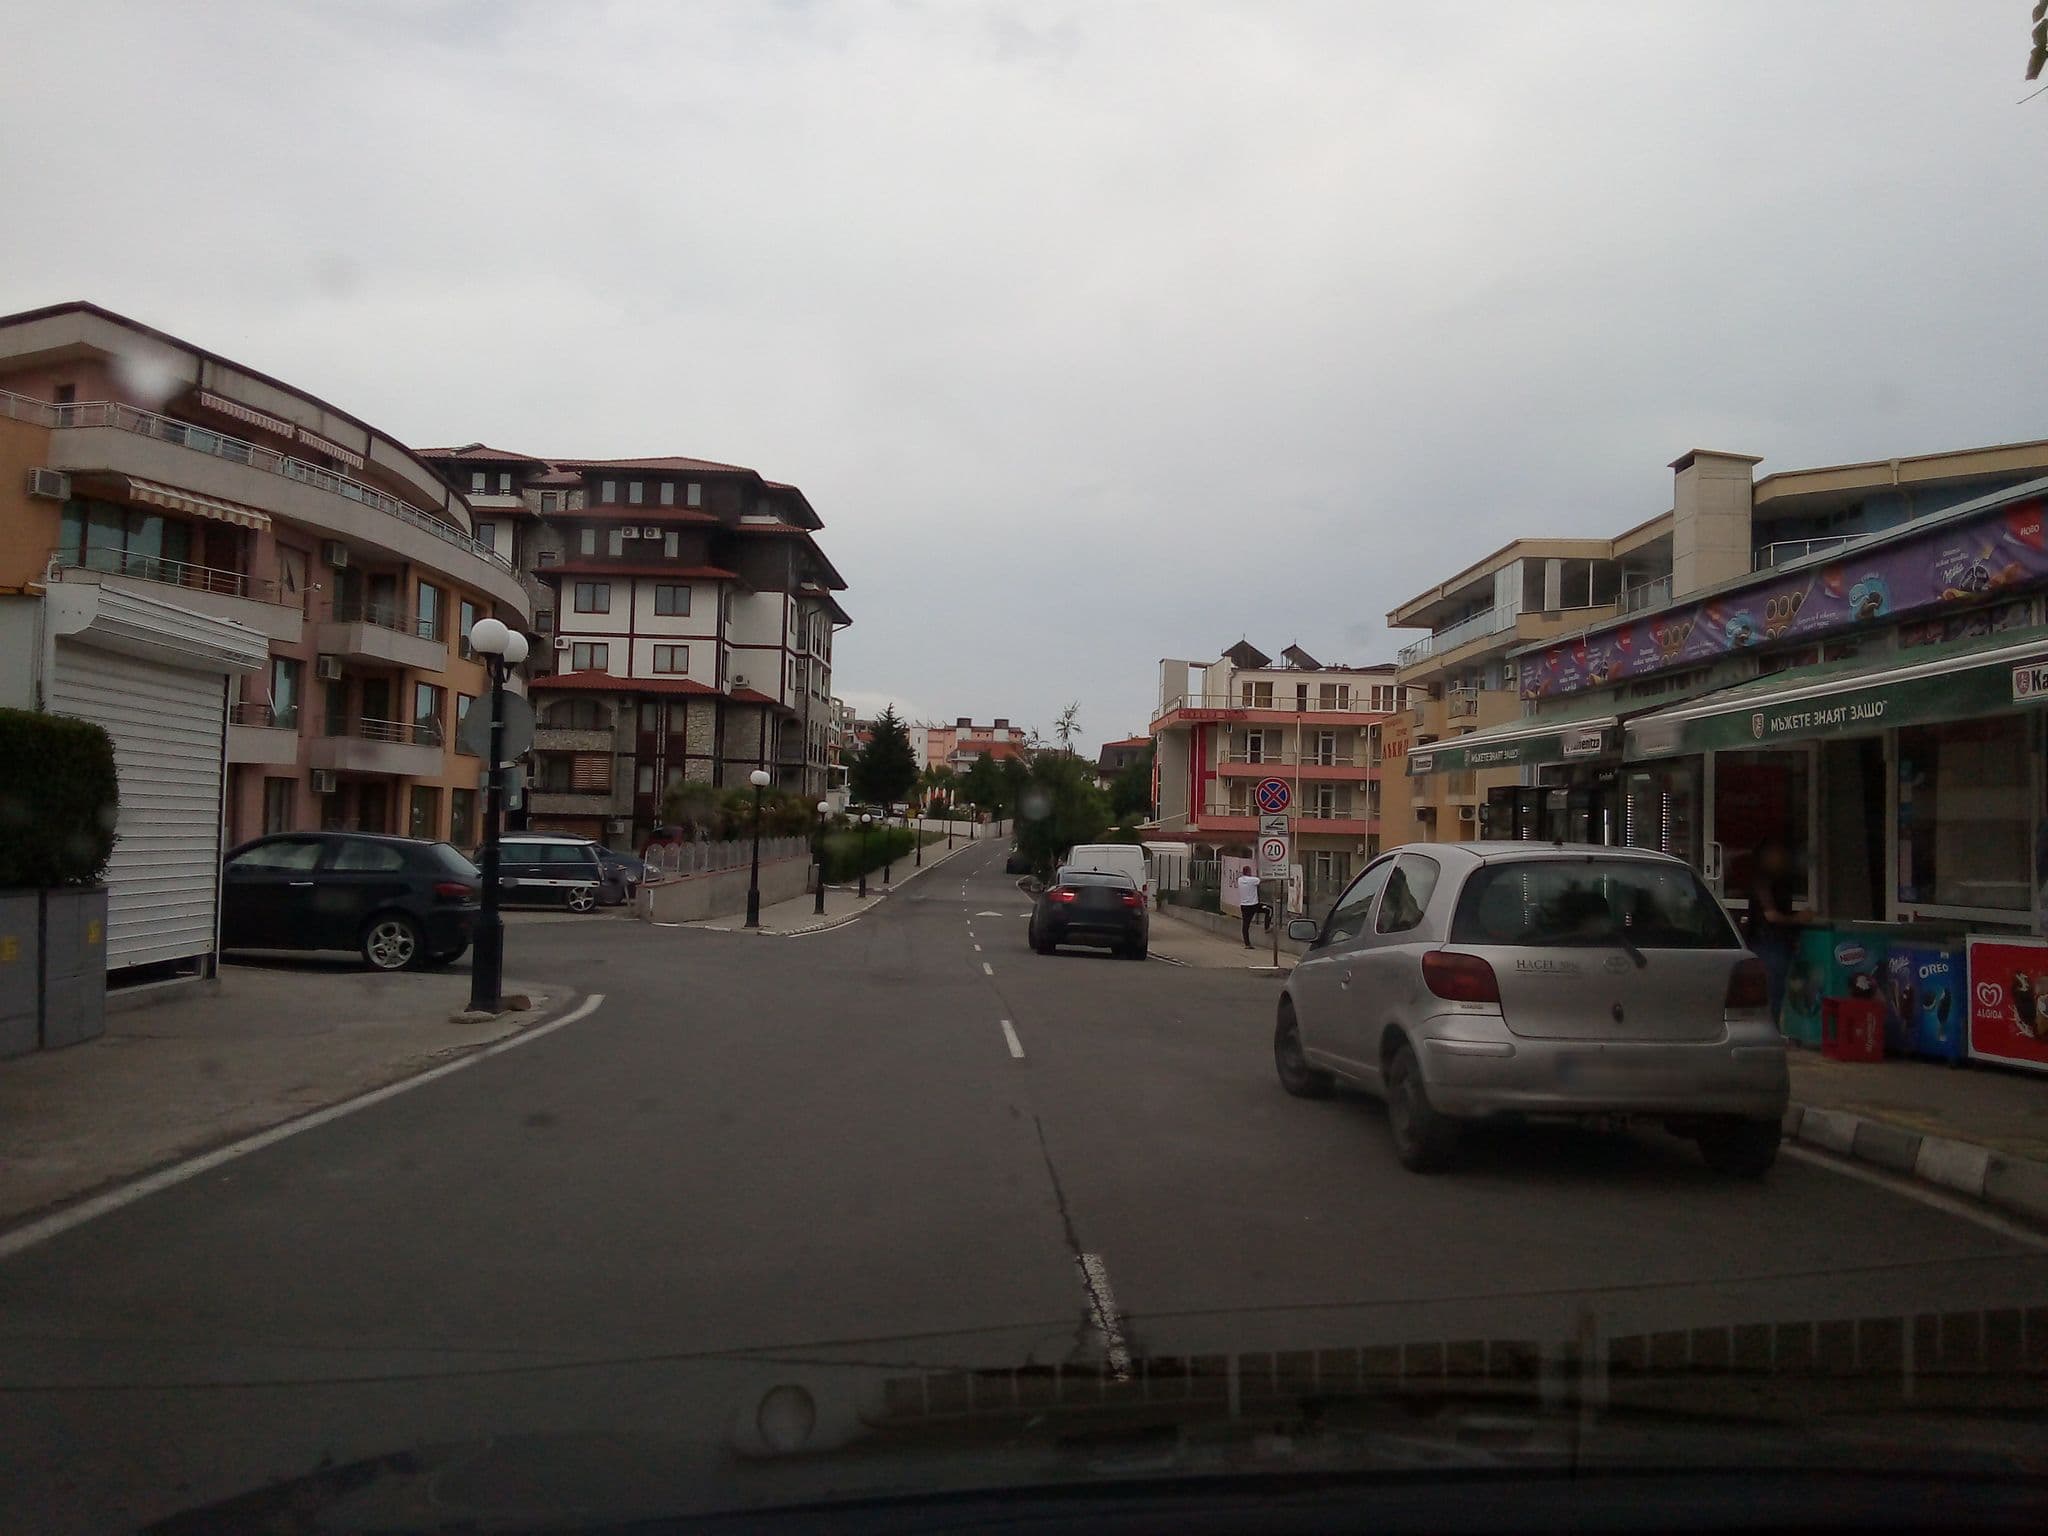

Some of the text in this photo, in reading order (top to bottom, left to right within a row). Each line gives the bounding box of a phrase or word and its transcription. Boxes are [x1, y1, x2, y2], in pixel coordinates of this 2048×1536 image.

[1771, 712, 1811, 732] МЪЖЕТЕ
[1814, 707, 1847, 726] ЗНАЯТ
[1267, 844, 1281, 856] 20
[1919, 962, 1949, 979] OREO
[1977, 1008, 2003, 1019] ALGIDA
